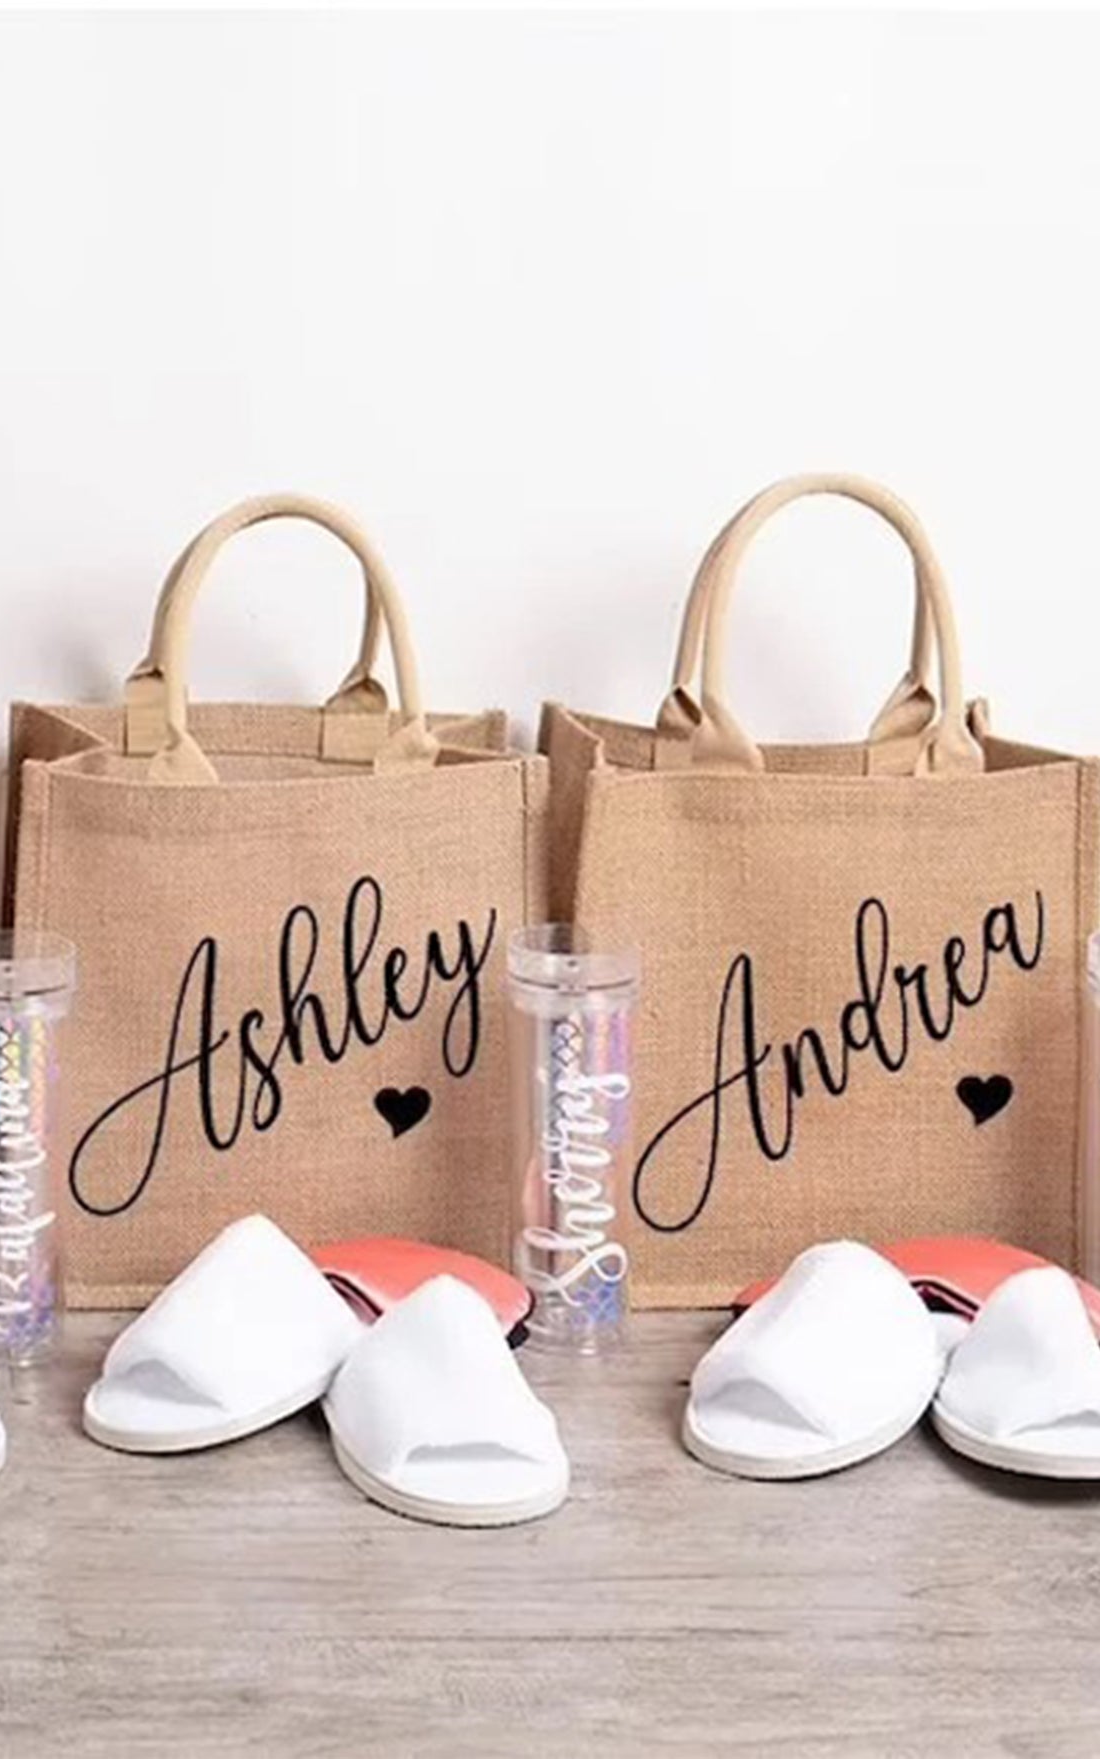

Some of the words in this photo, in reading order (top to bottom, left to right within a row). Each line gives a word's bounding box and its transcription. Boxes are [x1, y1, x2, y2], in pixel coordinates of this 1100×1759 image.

[69, 876, 497, 1217] Ashley
[520, 1068, 631, 1307] Sherry
[633, 890, 1044, 1232] Andrea
